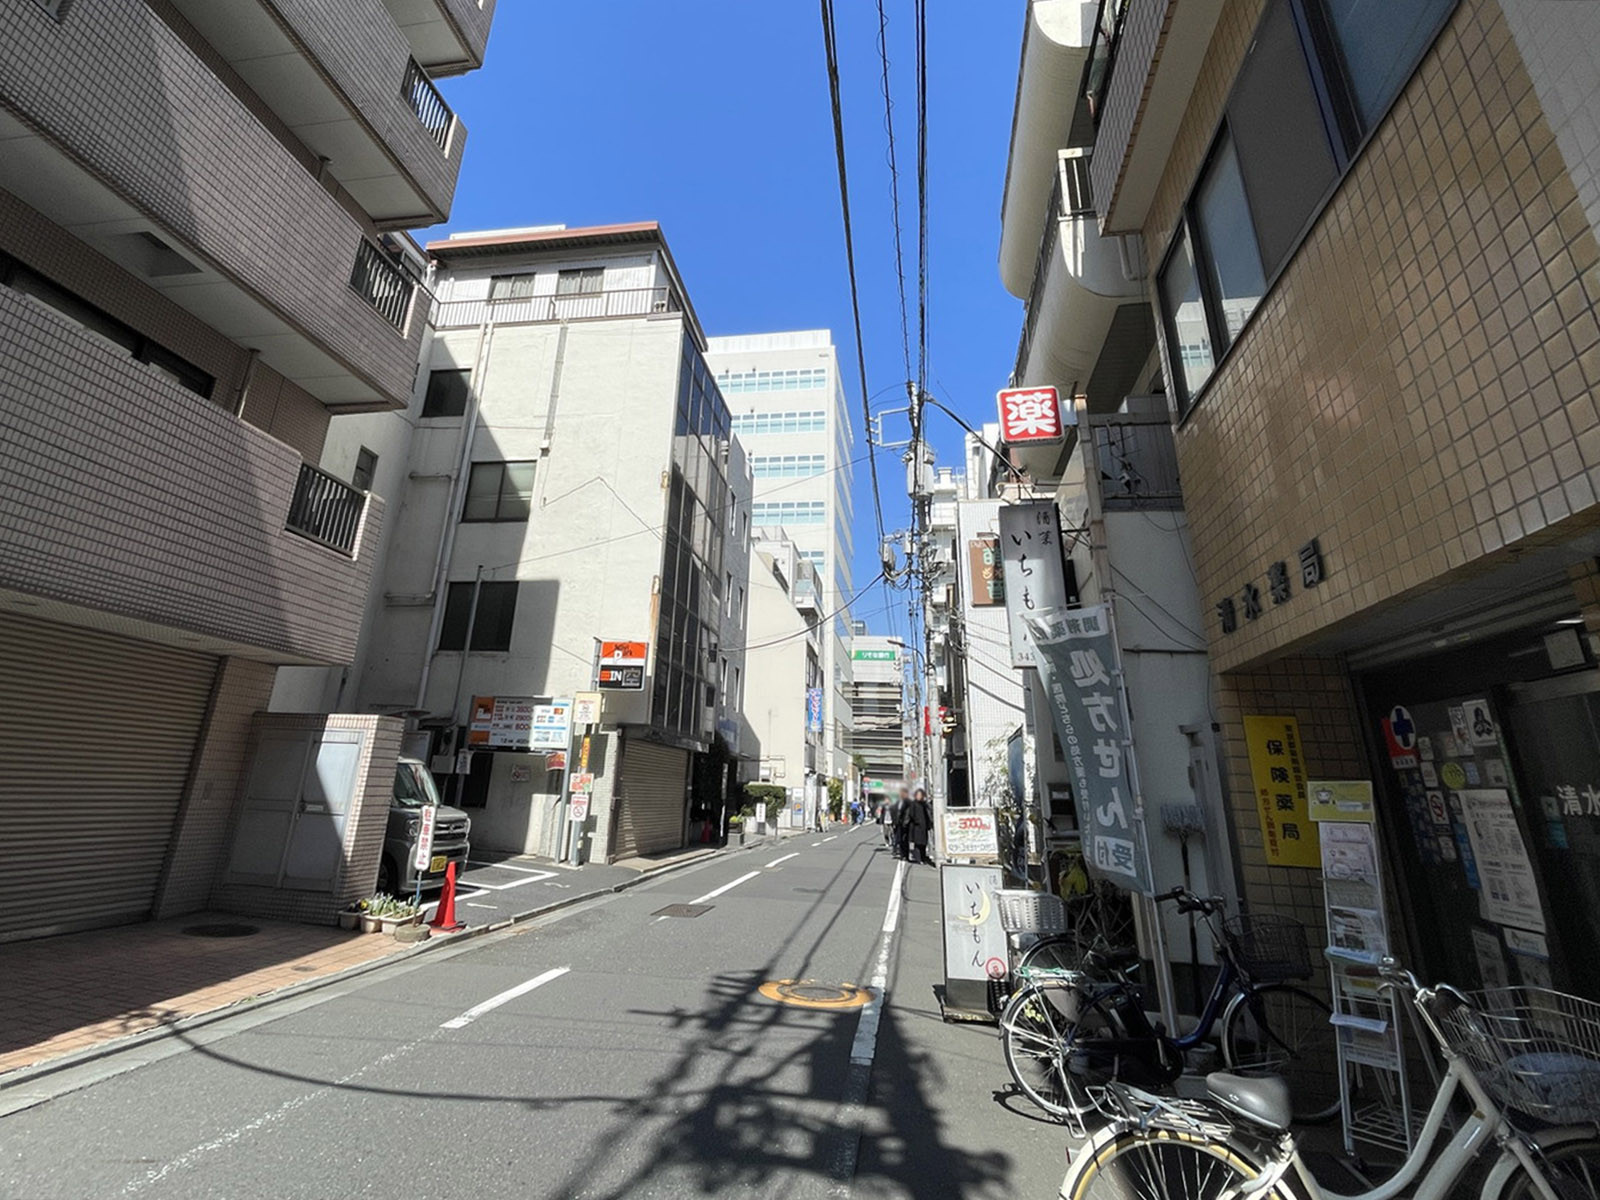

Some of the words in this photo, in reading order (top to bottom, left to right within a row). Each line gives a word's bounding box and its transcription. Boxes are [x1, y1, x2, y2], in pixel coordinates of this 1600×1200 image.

[1005, 392, 1057, 435] 薬
[1216, 537, 1325, 634] 清水薬局
[1266, 740, 1300, 840] 保険薬局
[1556, 784, 1600, 816] 清水
[965, 882, 985, 967] いちもん
